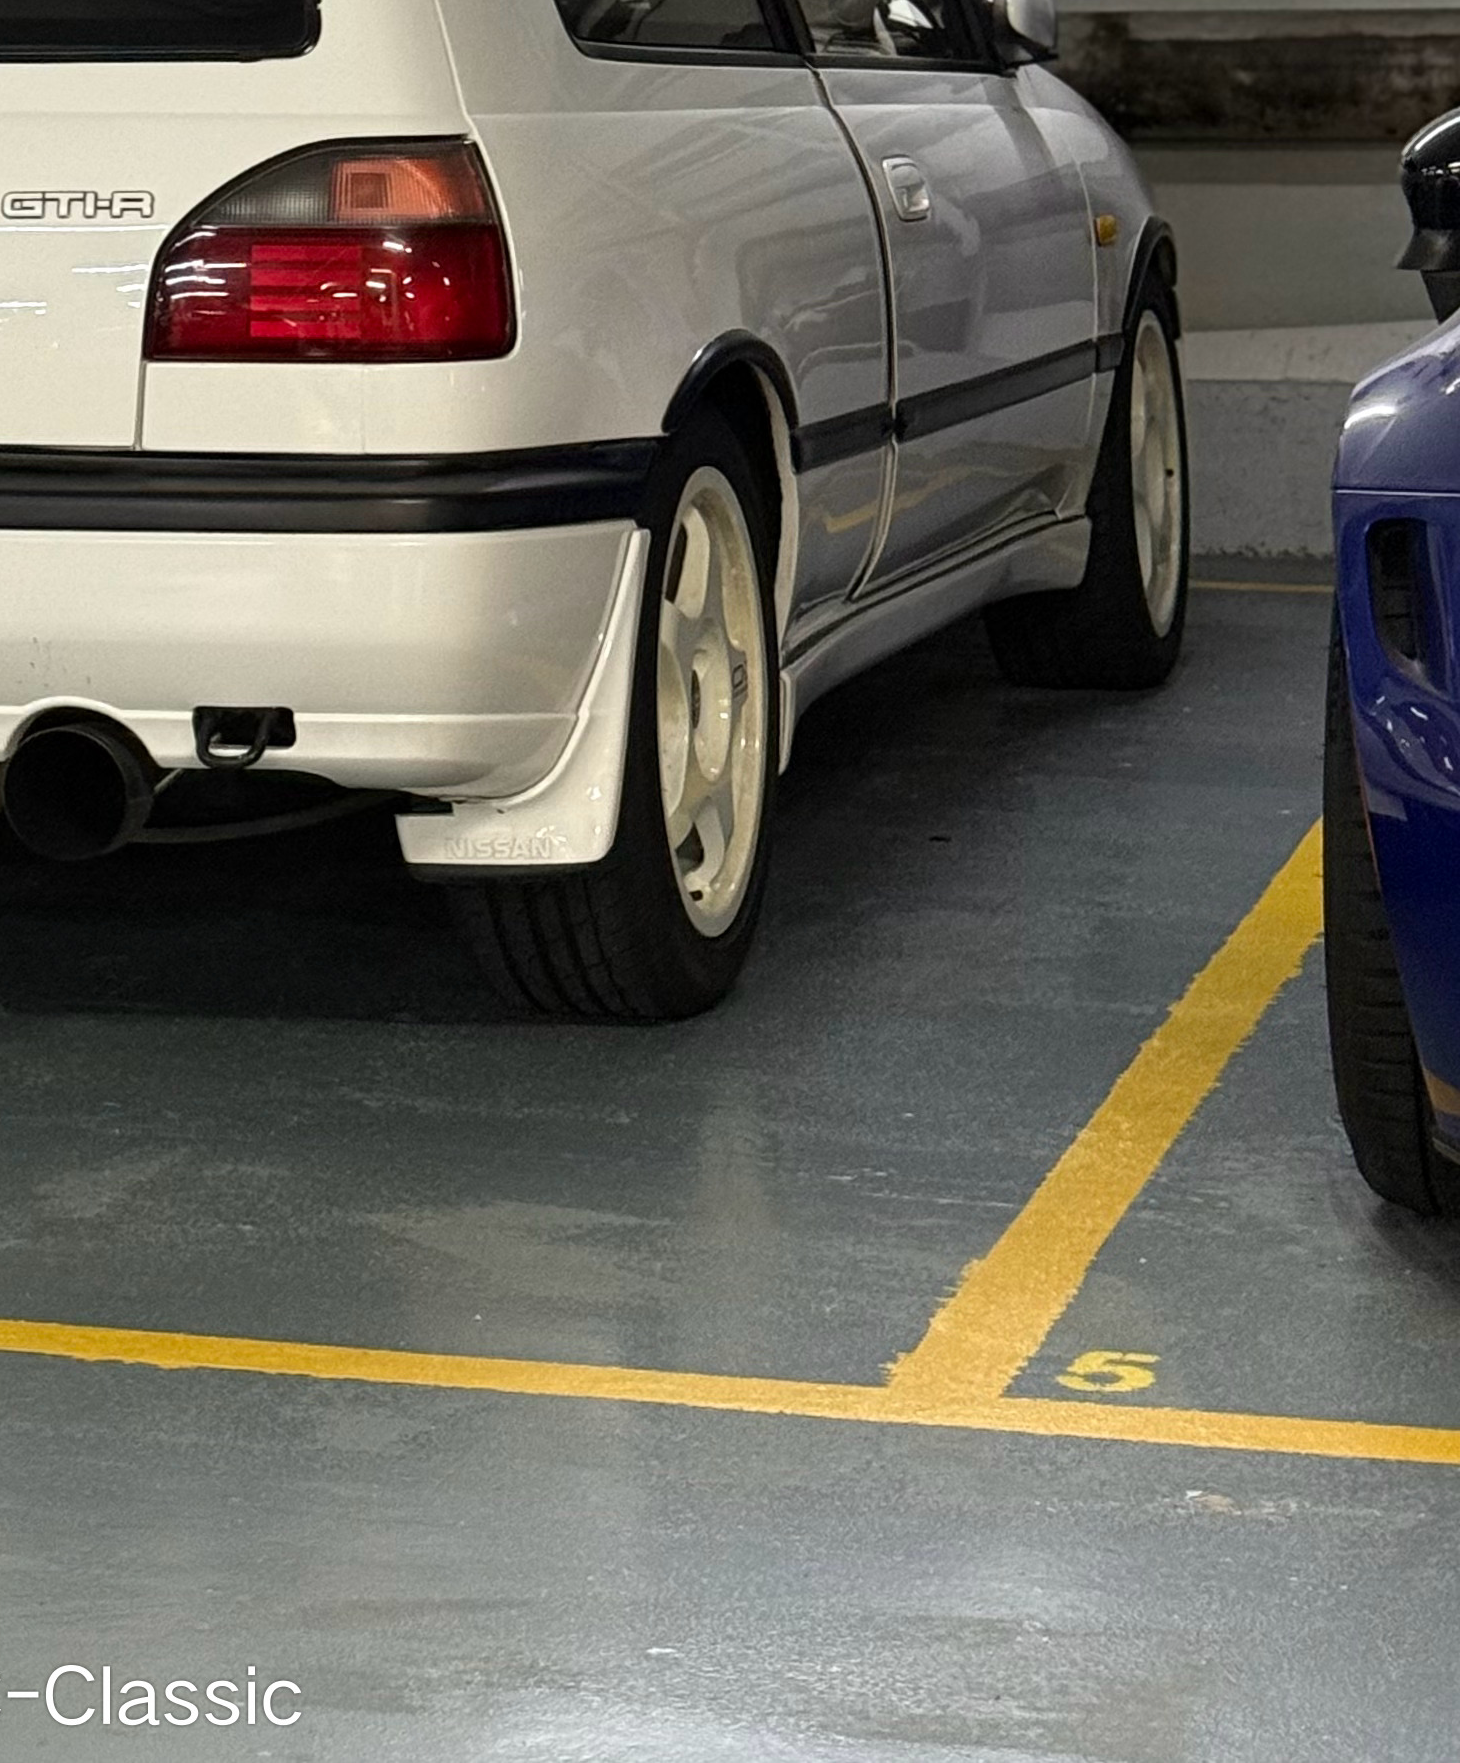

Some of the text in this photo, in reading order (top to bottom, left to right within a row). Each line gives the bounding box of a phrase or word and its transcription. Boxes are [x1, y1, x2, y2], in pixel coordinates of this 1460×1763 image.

[1, 190, 156, 220] GTI-R
[444, 837, 553, 860] NISSAN
[1055, 1349, 1162, 1393] 5
